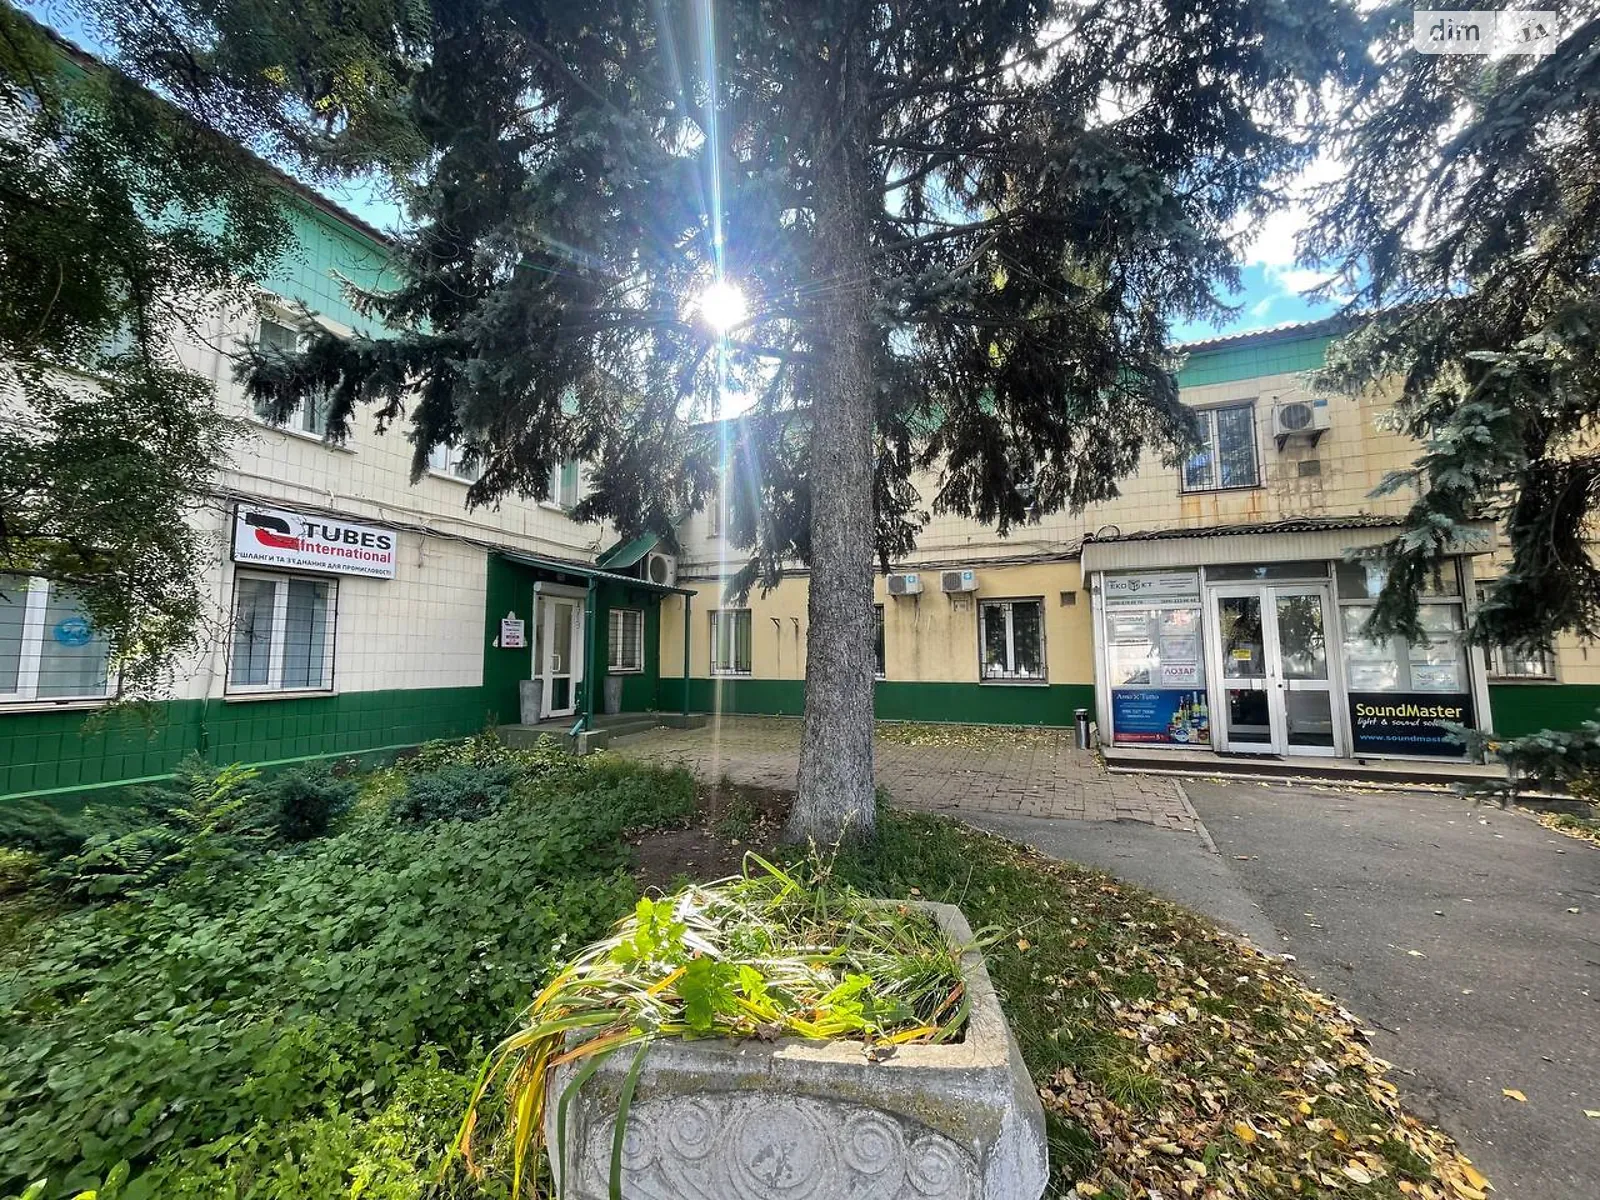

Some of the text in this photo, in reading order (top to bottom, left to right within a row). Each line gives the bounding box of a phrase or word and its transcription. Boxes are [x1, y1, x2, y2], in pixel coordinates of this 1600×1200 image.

[305, 522, 392, 550] TUBES
[299, 539, 391, 563] International
[239, 552, 275, 562] ШЛАНГИ
[276, 555, 286, 563] ТА
[327, 562, 342, 571] ДЛЯ
[1356, 703, 1463, 718] SoundMaster
[1357, 717, 1377, 729] light
[1380, 718, 1389, 726] &
[1391, 718, 1421, 726] sound
[1359, 734, 1441, 743] www.soundmast
